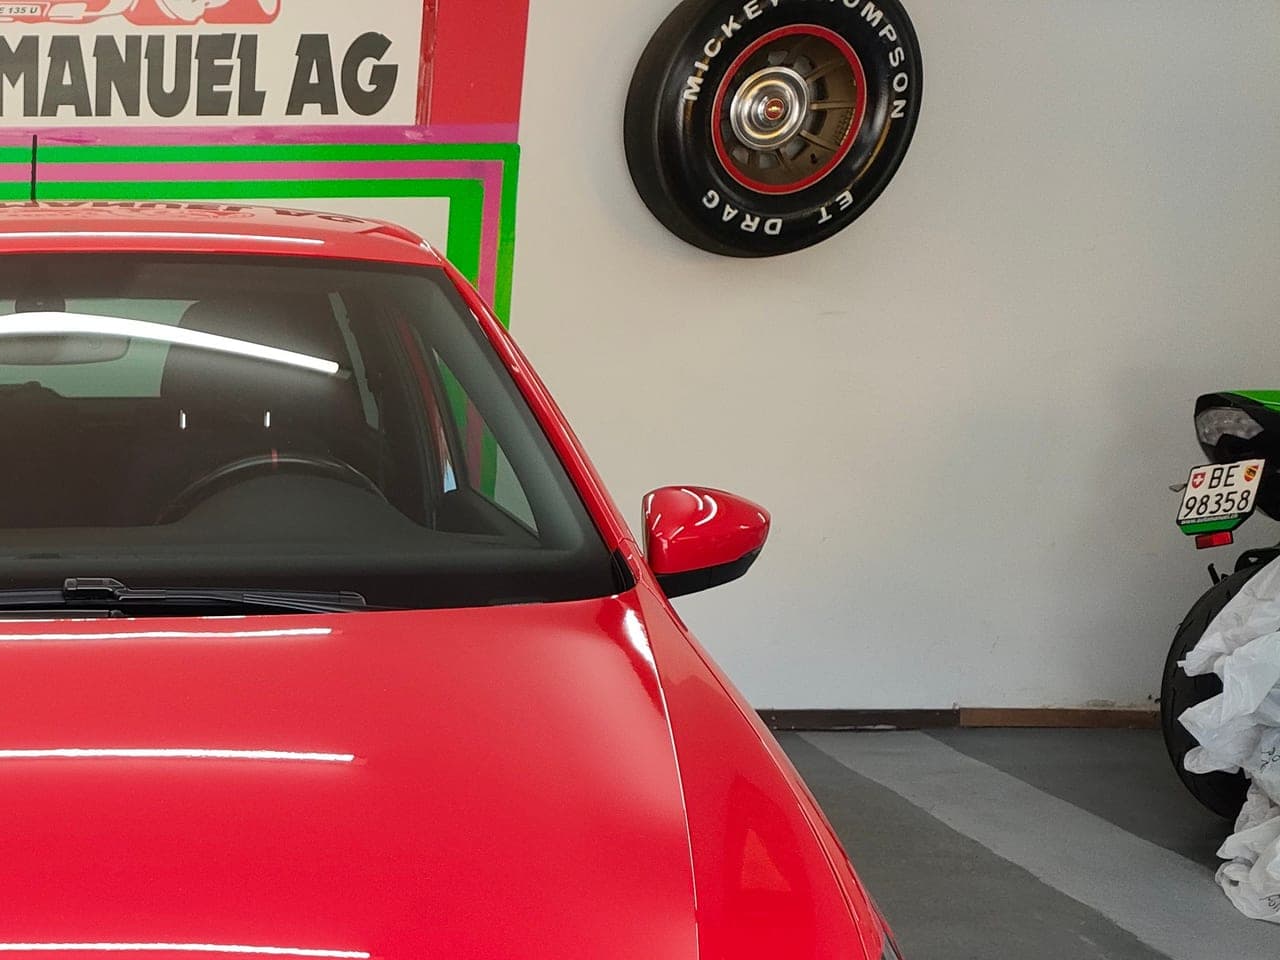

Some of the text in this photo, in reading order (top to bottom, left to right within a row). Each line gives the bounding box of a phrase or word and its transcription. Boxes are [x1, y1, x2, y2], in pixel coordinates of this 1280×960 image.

[285, 31, 399, 118] AG
[829, 0, 909, 120] MPSON
[702, 189, 854, 235] ET DRAG
[1208, 465, 1241, 490] BE
[1183, 490, 1252, 518] 98358
